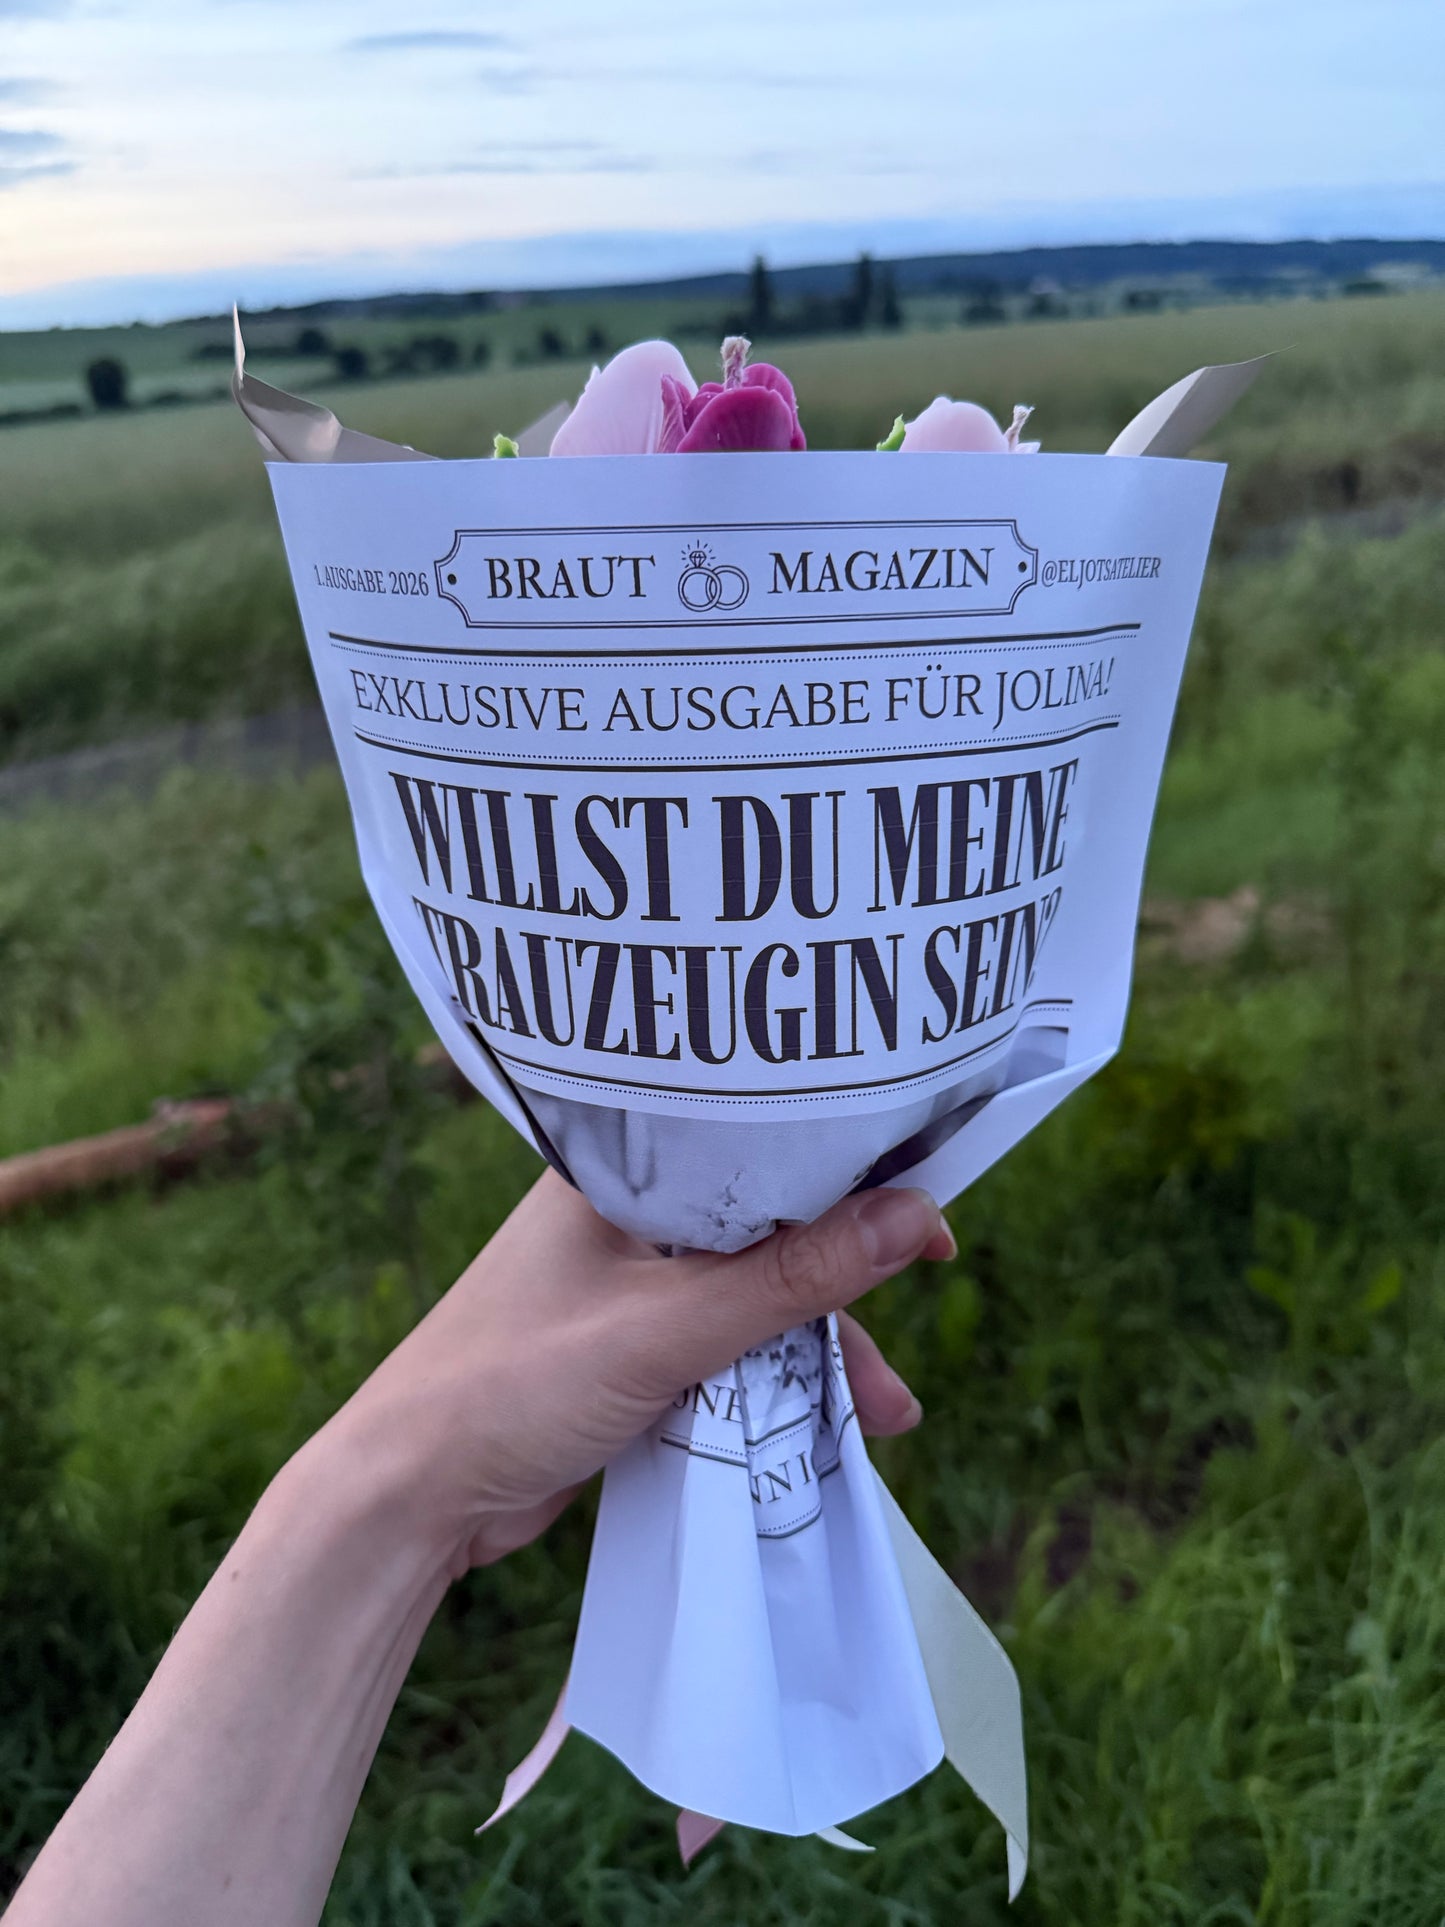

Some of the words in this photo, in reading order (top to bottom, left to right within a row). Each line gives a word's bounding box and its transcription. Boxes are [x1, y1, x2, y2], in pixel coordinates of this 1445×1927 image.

[388, 571, 430, 596] 2026
[484, 555, 656, 599] BRAUT
[767, 548, 996, 594] MAGAZIN
[1041, 556, 1161, 590] @ELJOTSATELIER
[349, 668, 589, 731] EXKLUSIVE
[602, 680, 870, 732] AUSGABE
[884, 664, 992, 722] FÜR
[992, 656, 1115, 732] JOLINA!
[388, 770, 689, 922] WILLST
[711, 790, 846, 922] DU
[866, 758, 1079, 912] MEINE
[412, 894, 905, 1065] TRAUZEUGIN
[921, 885, 1062, 1045] SEIN?
